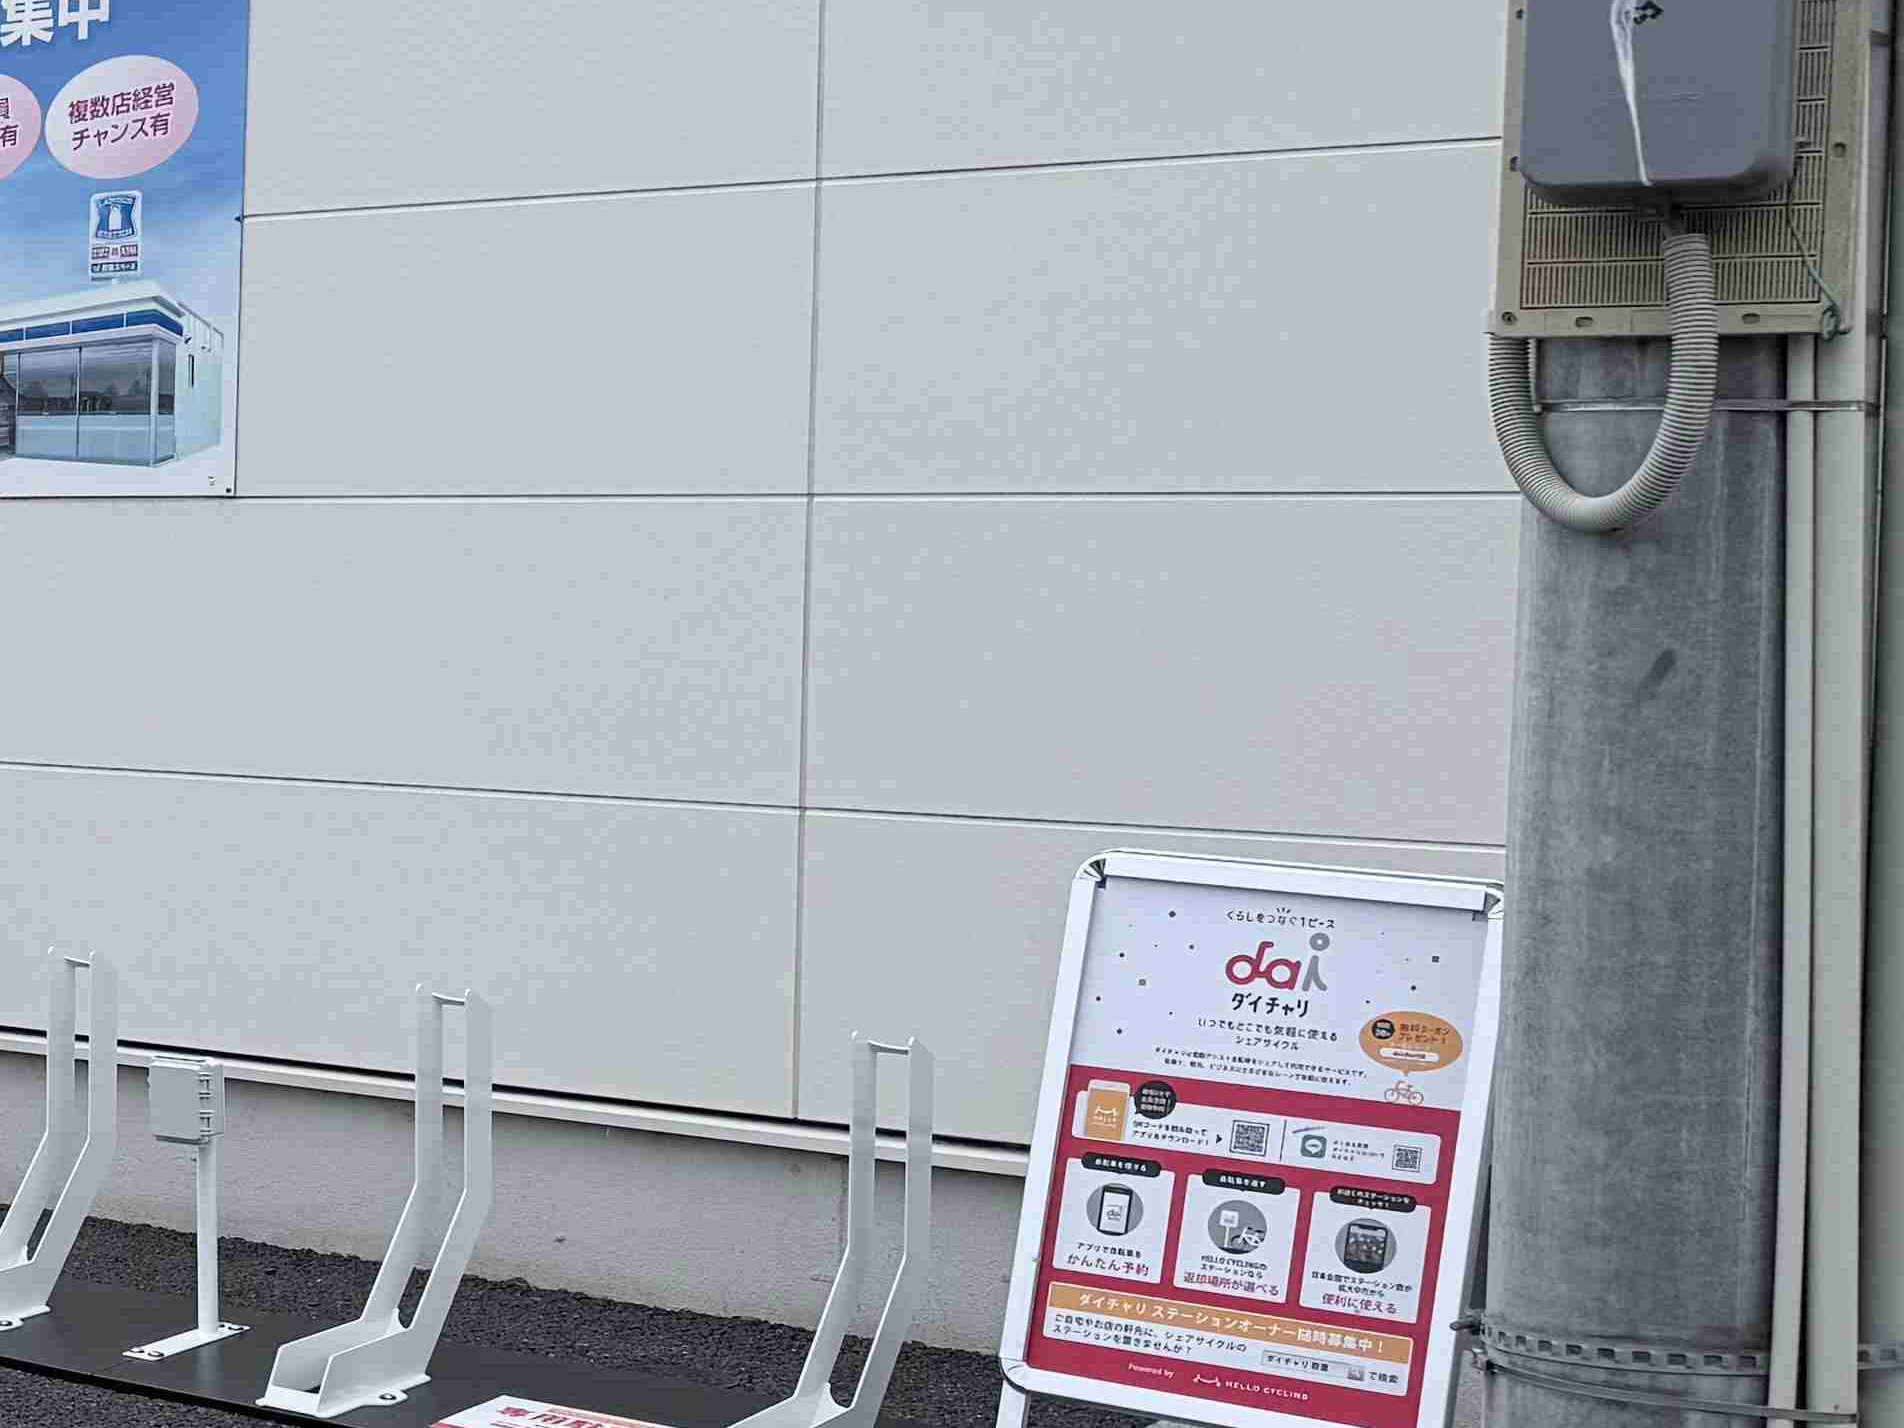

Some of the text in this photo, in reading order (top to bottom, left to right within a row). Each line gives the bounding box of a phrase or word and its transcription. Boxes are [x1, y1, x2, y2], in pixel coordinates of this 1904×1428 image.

[68, 82, 176, 125] 複数店経営
[72, 112, 172, 151] チャンス有
[1225, 932, 1330, 992] dai
[1231, 992, 1310, 1018] ダイチャリ
[1235, 1035, 1299, 1051] シェアサイクル
[1079, 1293, 1147, 1316] ダイチャリ
[1225, 1380, 1261, 1393] HELLO
